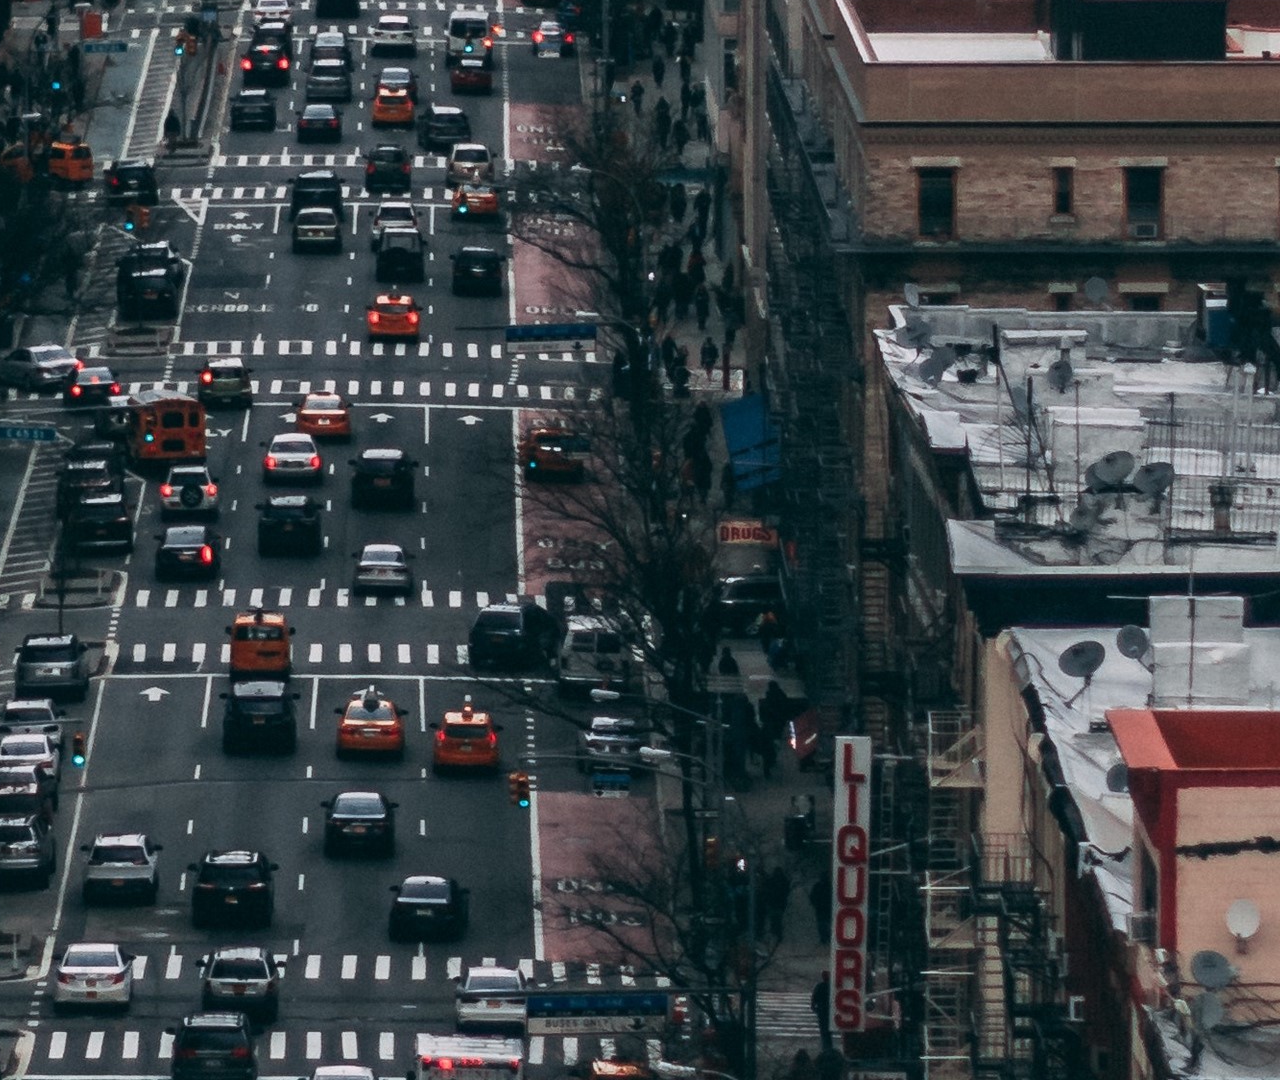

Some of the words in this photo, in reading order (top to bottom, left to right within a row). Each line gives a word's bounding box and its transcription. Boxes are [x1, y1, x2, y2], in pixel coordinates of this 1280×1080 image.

[213, 222, 265, 231] ONLY
[720, 525, 772, 541] DRUGS
[834, 743, 868, 1030] LIQUORS
